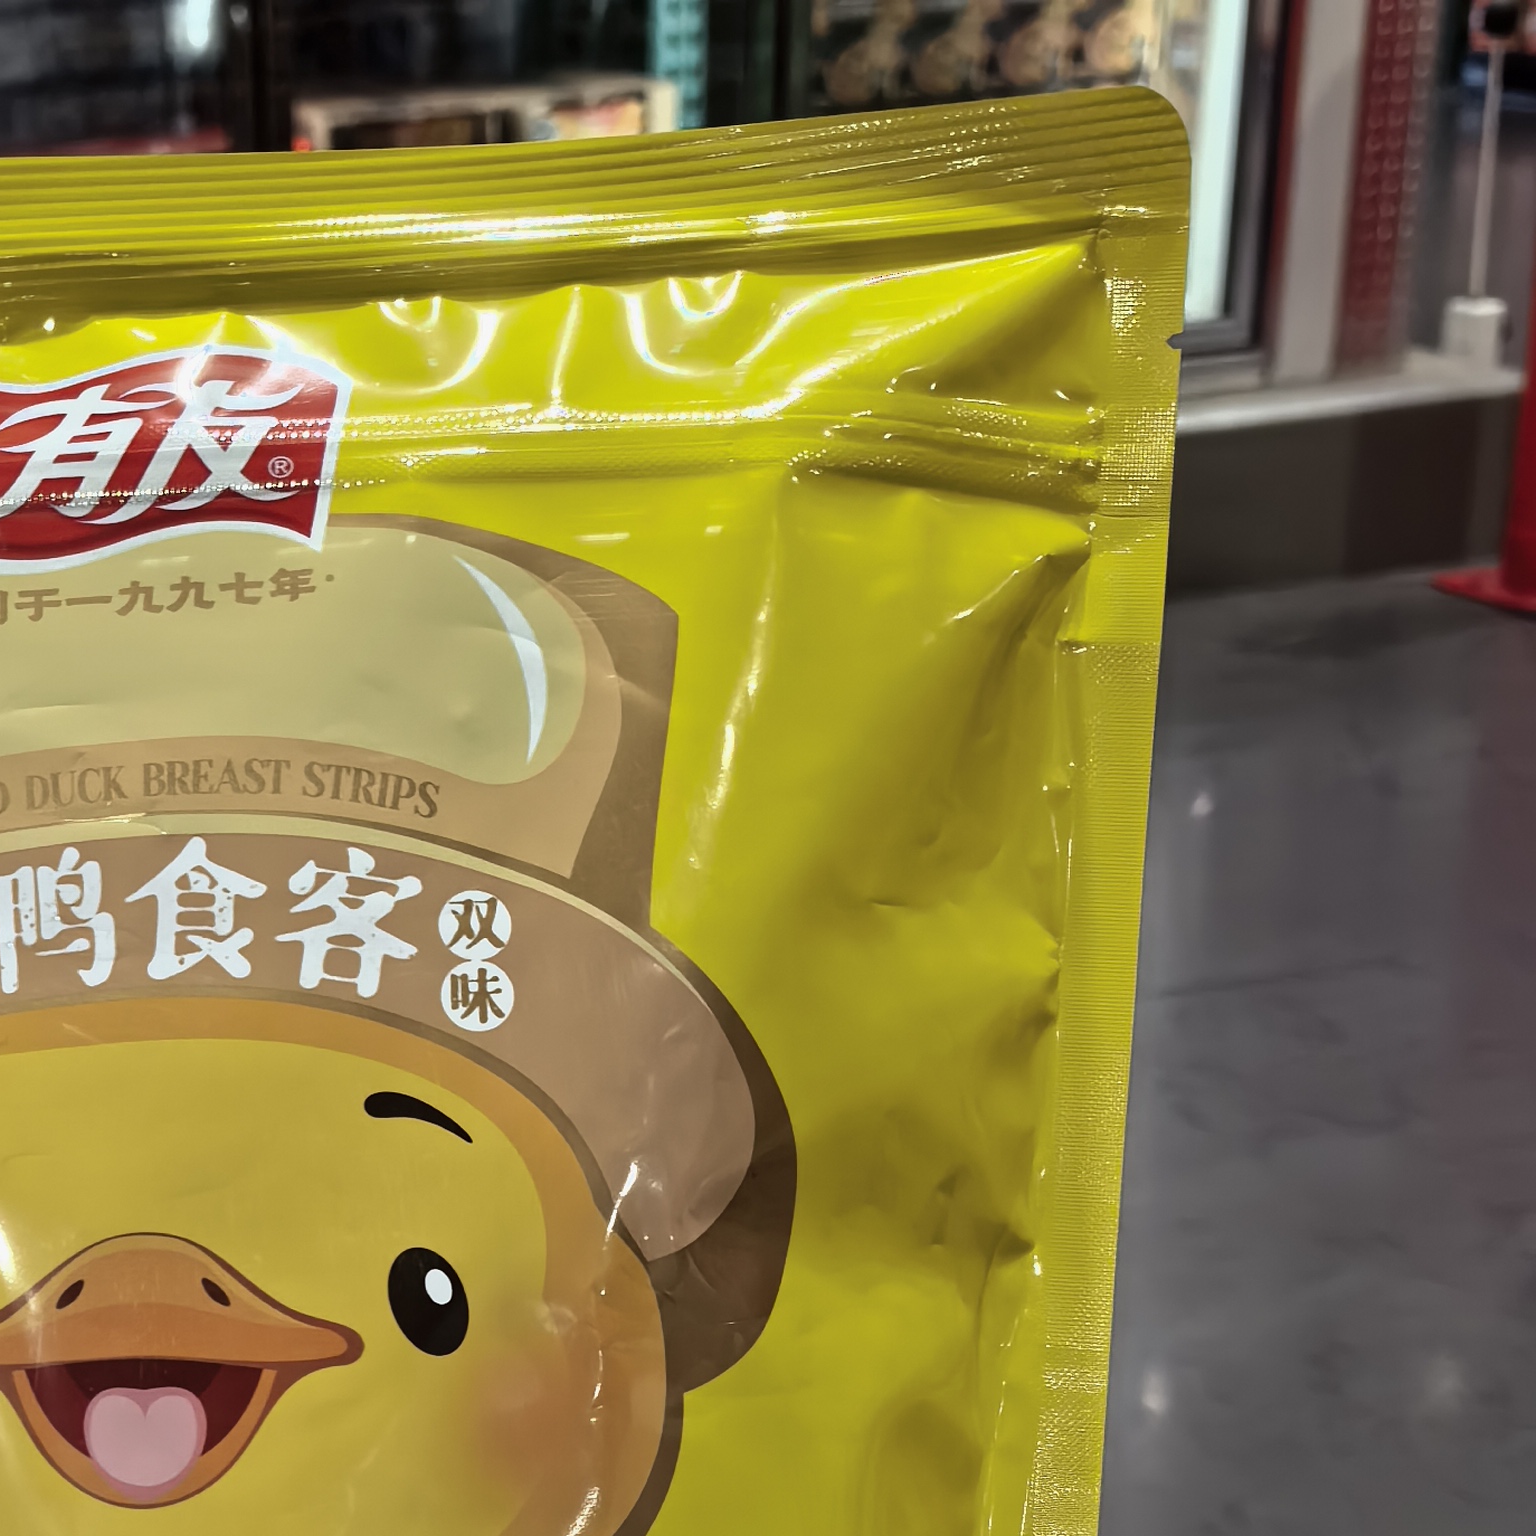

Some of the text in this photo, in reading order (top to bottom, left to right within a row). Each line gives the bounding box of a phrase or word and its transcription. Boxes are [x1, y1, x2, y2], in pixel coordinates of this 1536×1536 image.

[25, 764, 129, 811] DUCK
[142, 757, 291, 798] BREAST
[302, 760, 441, 819] STRIPS
